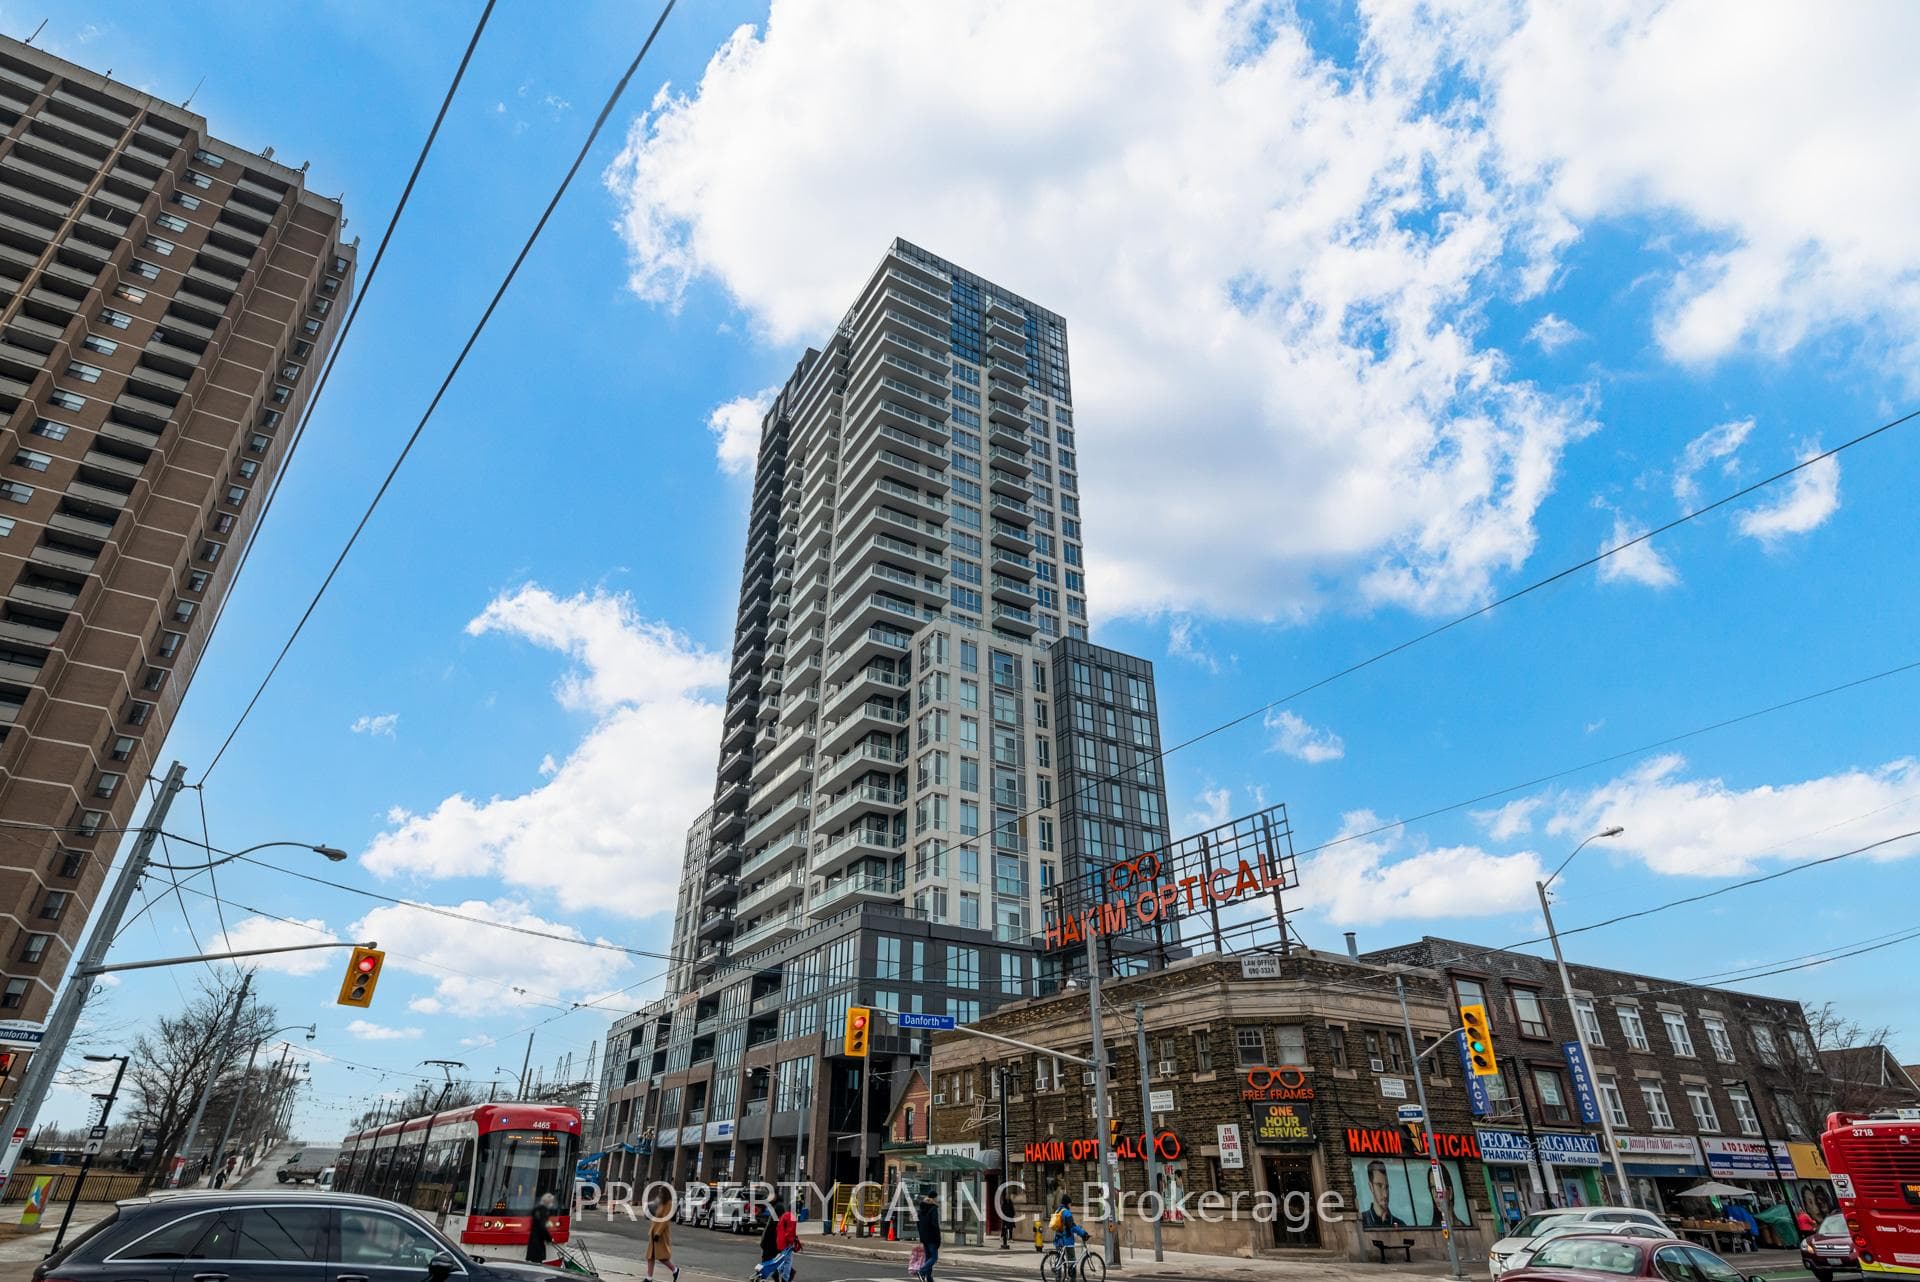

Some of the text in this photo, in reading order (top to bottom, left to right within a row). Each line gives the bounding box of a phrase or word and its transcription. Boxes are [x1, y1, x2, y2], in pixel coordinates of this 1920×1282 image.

[1045, 854, 1286, 950] HAKIM OPTICAL
[905, 1015, 940, 1026] Danforth
[0, 1030, 29, 1039] anforth
[1568, 1047, 1595, 1120] PHARMACY
[1242, 1088, 1315, 1100] FREE FRAMES
[1269, 1105, 1294, 1116] ONE
[533, 1121, 551, 1129] 4465
[1265, 1116, 1300, 1127] HOUR
[1260, 1127, 1309, 1138] SERVICE
[1852, 1128, 1874, 1137] 3718
[1222, 1142, 1239, 1150] CENTRE
[1347, 1128, 1482, 1157] HAKIM PTICAL
[1564, 1137, 1597, 1153] MART
[1025, 1140, 1065, 1162] HAKIM
[1071, 1137, 1137, 1160] OPTAL
[1483, 1149, 1528, 1161] PHARMACY
